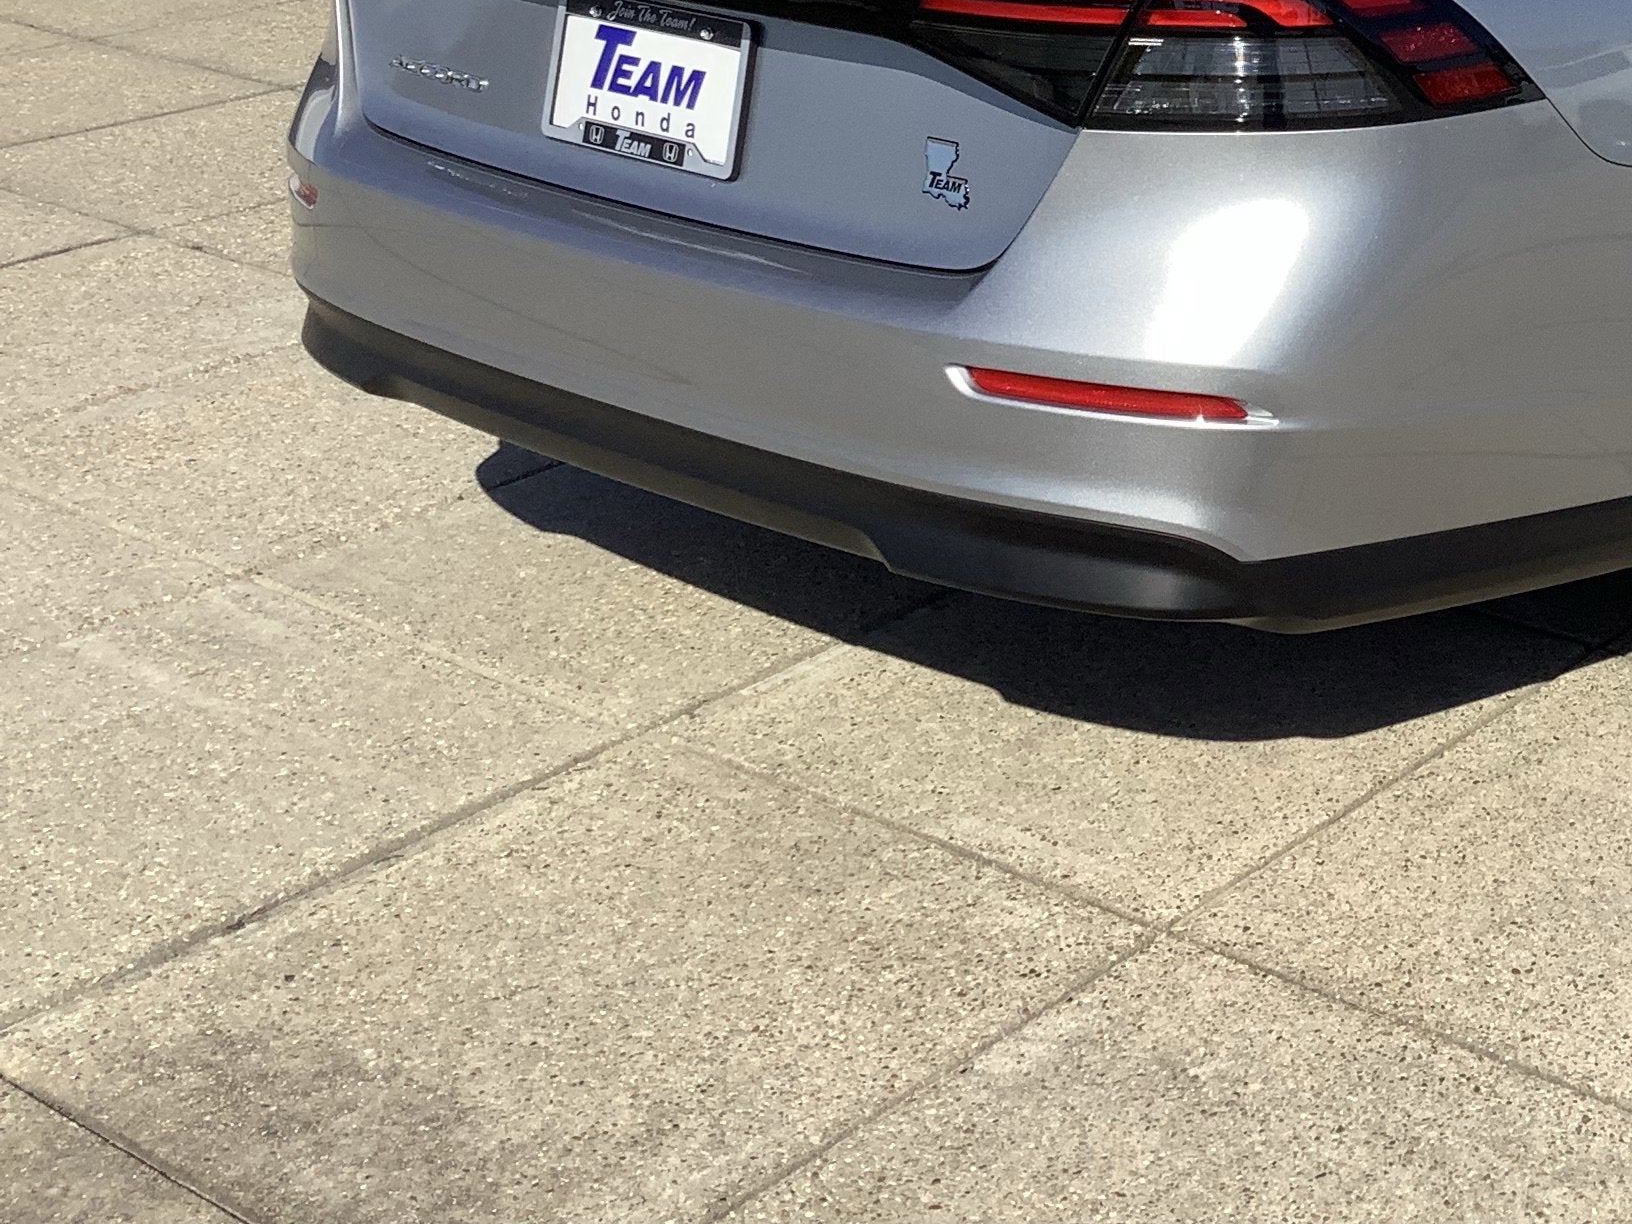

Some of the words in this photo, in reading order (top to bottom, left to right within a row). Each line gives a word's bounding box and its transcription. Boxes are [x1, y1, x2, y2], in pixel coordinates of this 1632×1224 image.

[607, 0, 636, 21] Join
[638, 5, 658, 24] The
[660, 8, 696, 32] Team!
[590, 24, 707, 111] TEAM
[585, 94, 696, 139] Honda
[614, 130, 652, 158] TEAM
[928, 171, 963, 194] TEAM
